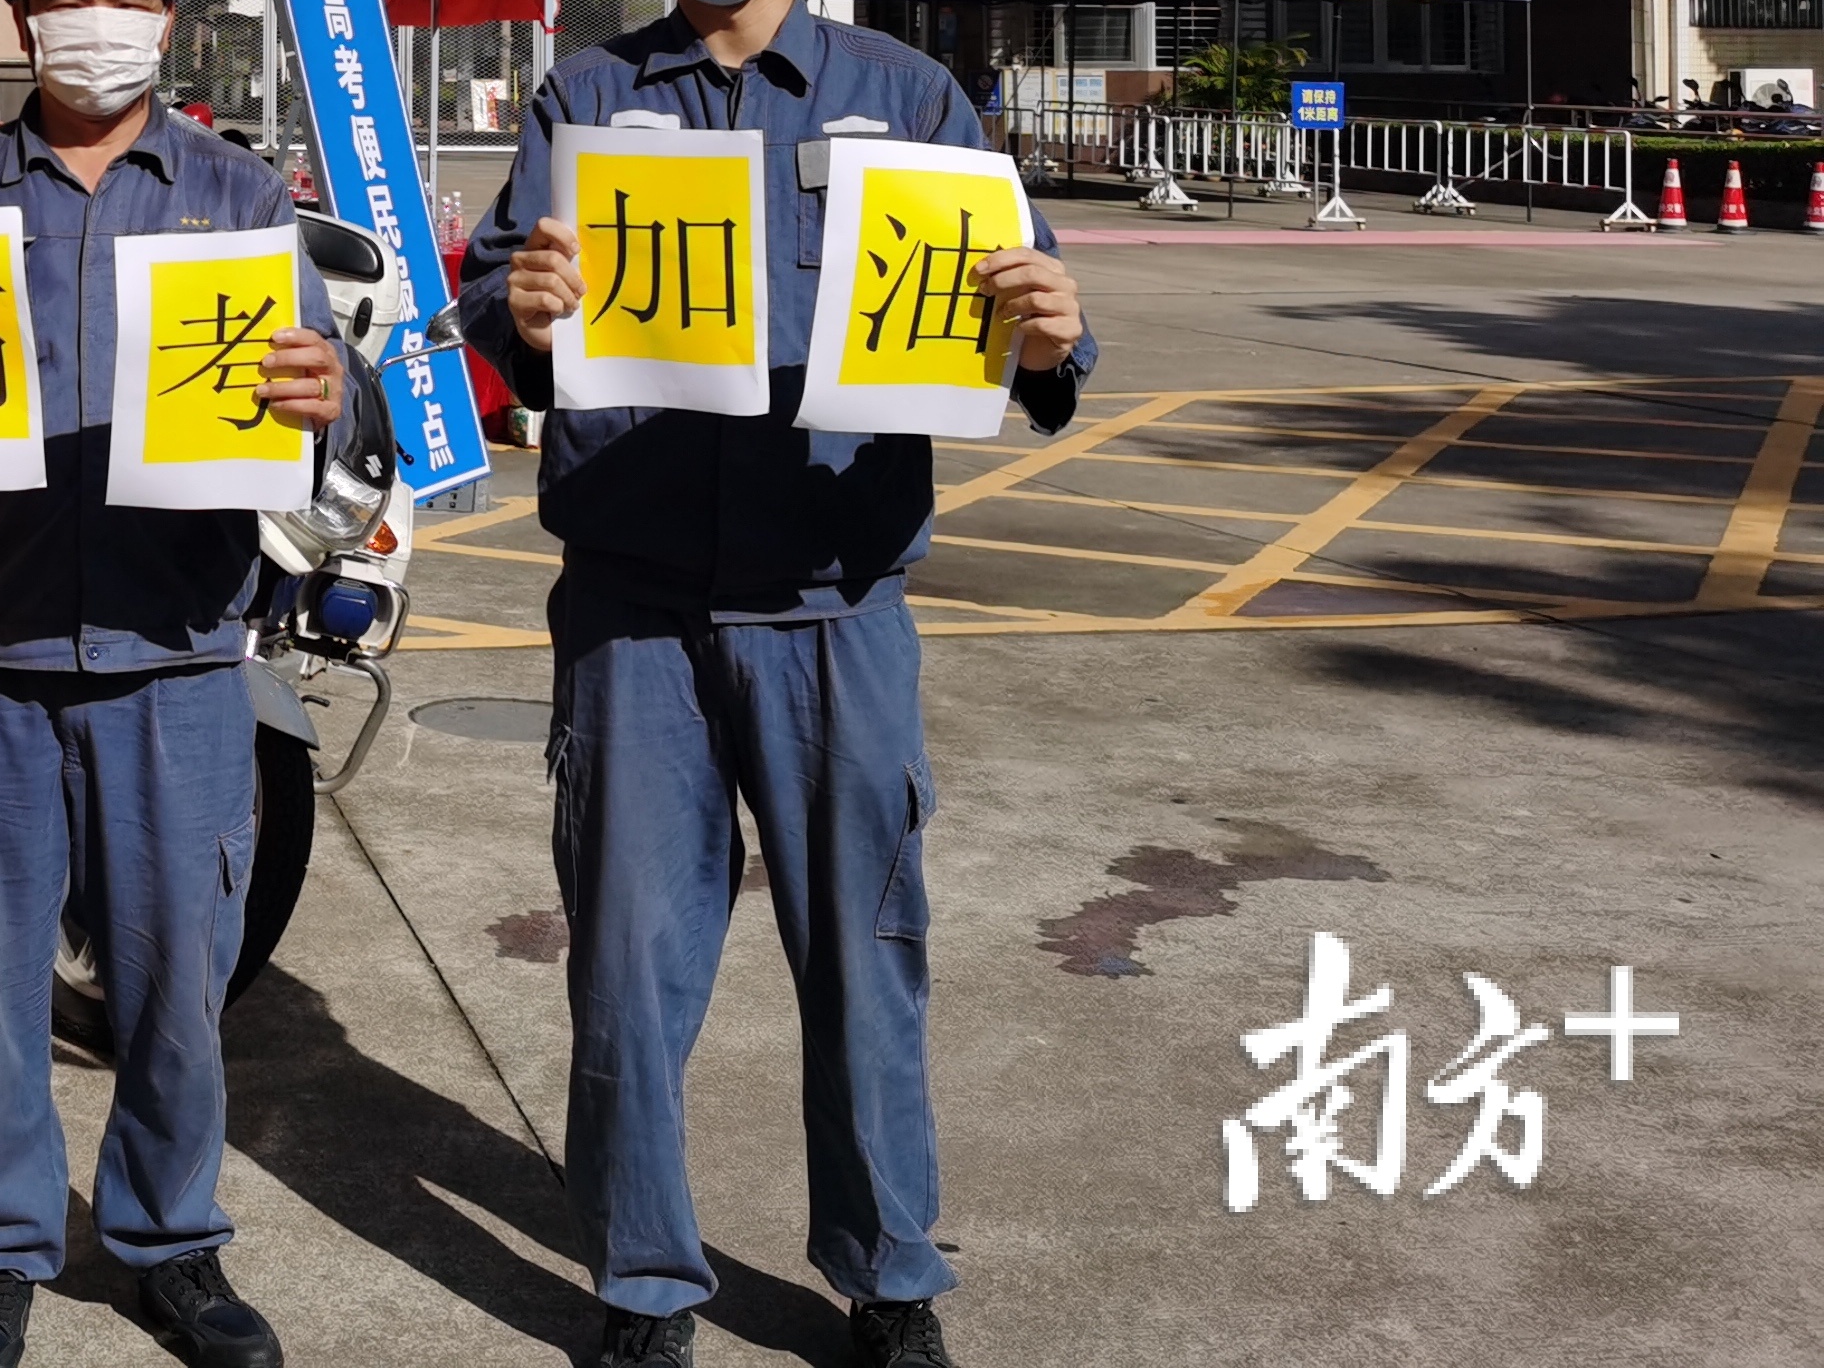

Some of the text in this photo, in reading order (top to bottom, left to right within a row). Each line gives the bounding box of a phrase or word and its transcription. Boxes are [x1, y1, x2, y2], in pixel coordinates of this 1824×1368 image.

[585, 188, 737, 330] 加
[858, 207, 1004, 355] 油
[156, 292, 277, 431] 考
